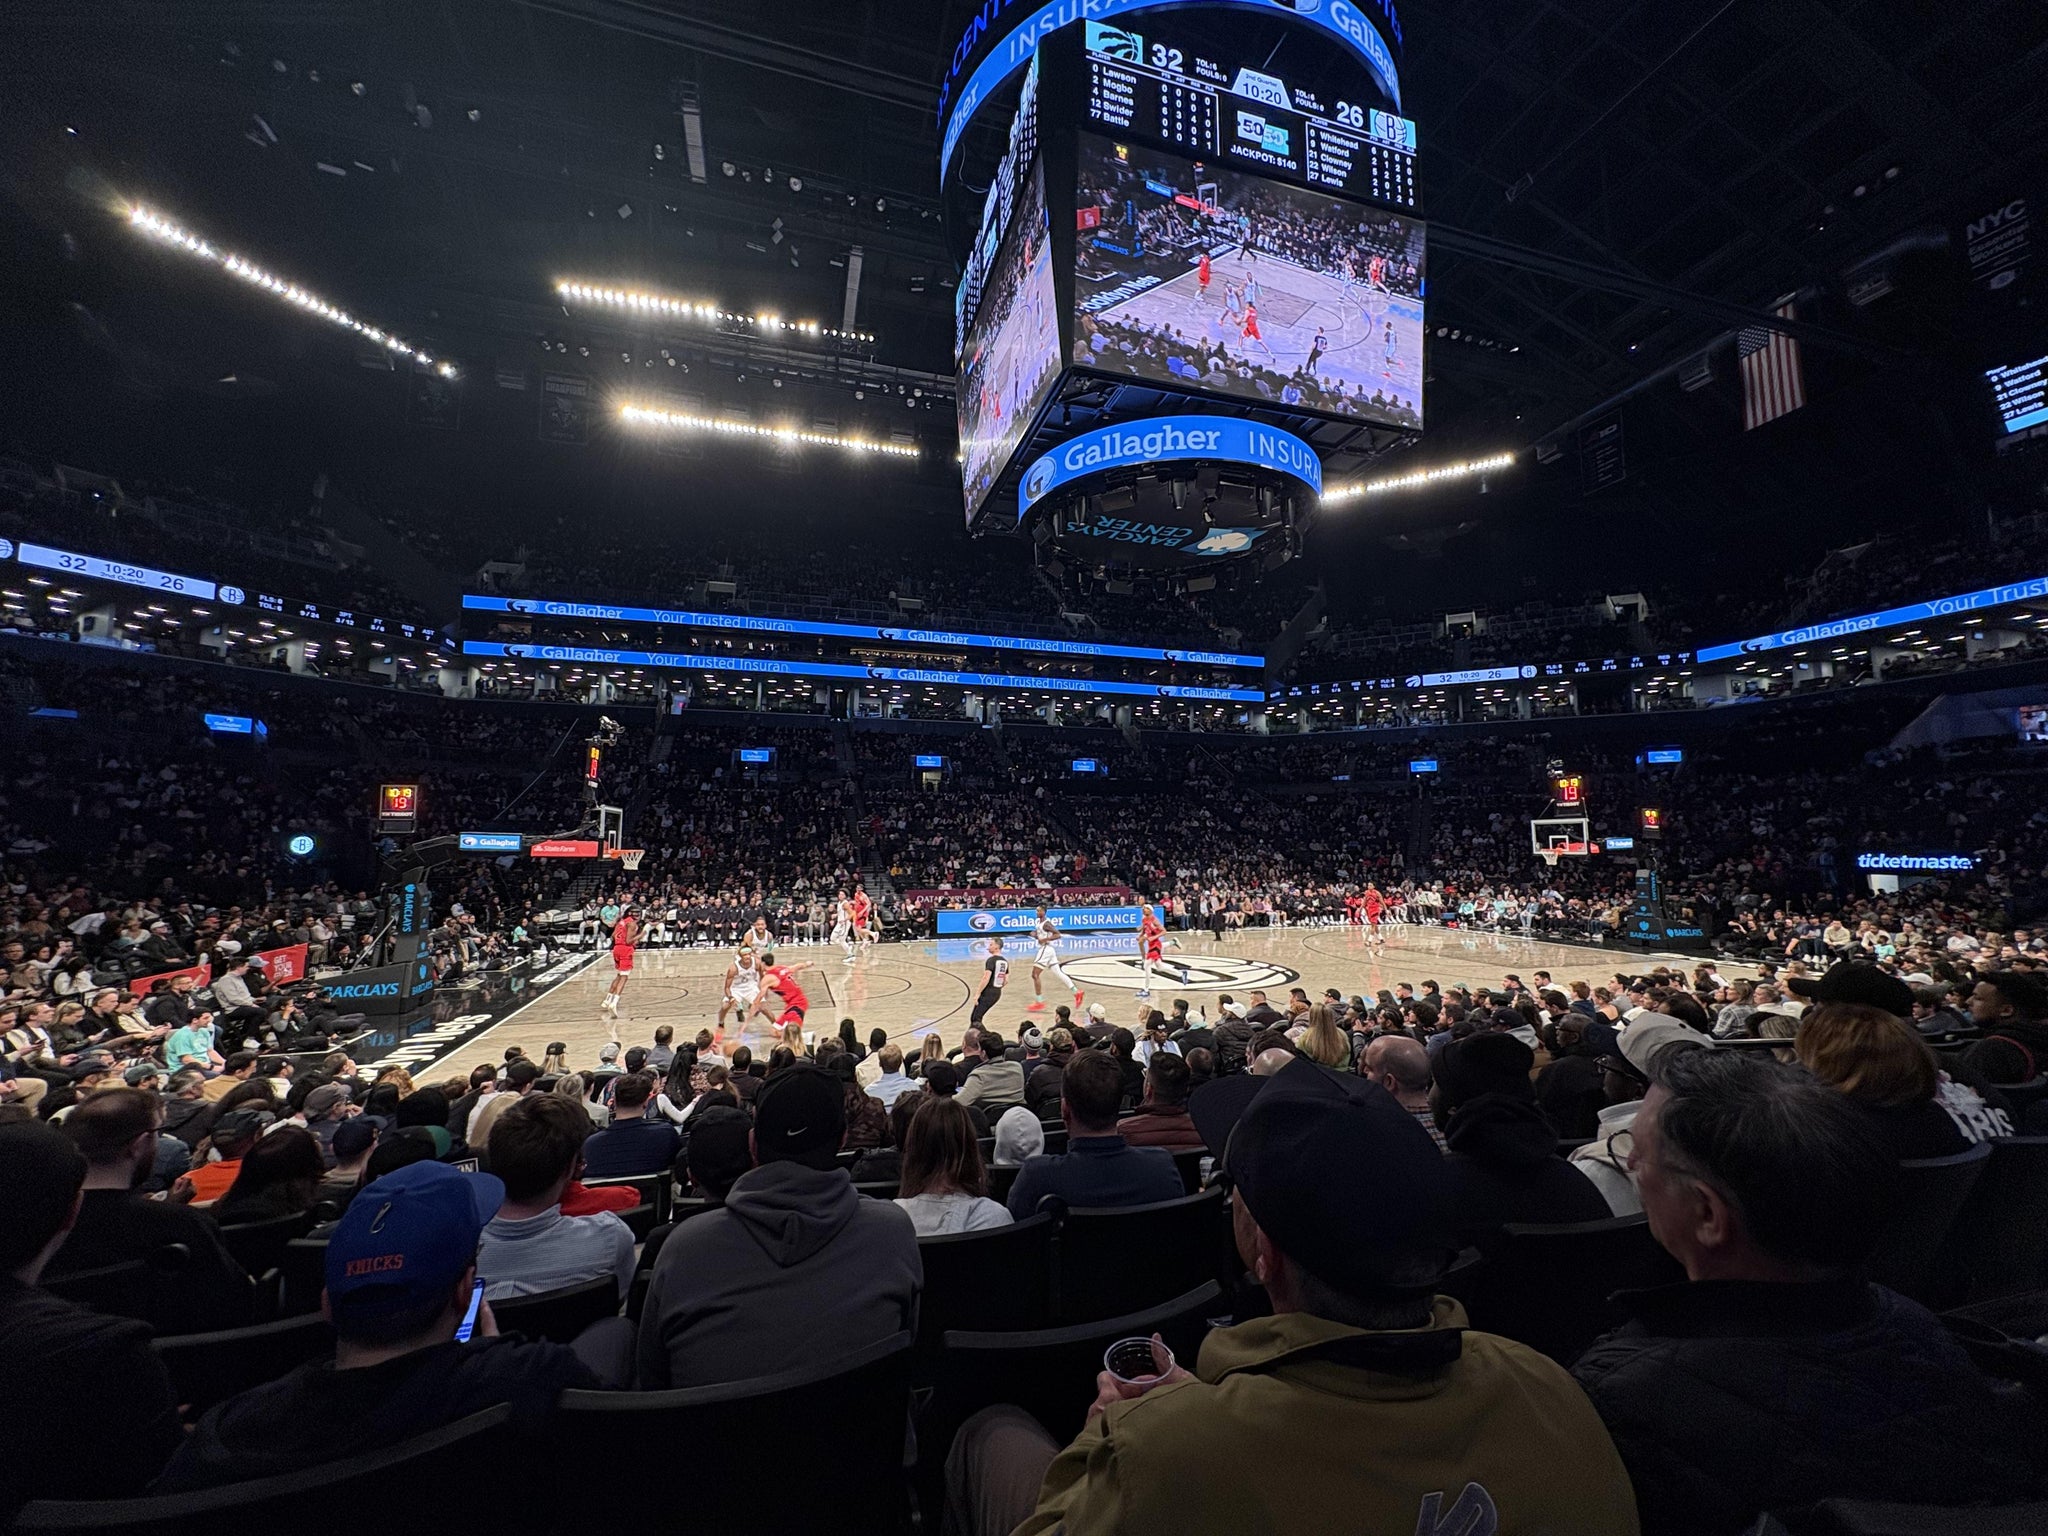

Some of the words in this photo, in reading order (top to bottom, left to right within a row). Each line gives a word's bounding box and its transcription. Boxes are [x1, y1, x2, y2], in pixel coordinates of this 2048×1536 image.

[1152, 43, 1183, 73] 32
[1092, 64, 1098, 72] 0
[1103, 66, 1136, 84] Lawson
[1257, 76, 1277, 87] Quarter
[1093, 76, 1098, 84] 2
[1103, 78, 1133, 94] Mogbo
[1243, 83, 1282, 105] 10:20
[1093, 87, 1098, 95] 4
[1103, 91, 1134, 106] Barnes
[1091, 98, 1101, 107] 12
[1103, 102, 1133, 117] Swider
[1336, 101, 1364, 128] 26
[1090, 109, 1101, 118] 77
[1104, 113, 1129, 127] Battle
[1243, 119, 1263, 136] 50
[1310, 129, 1315, 137] 0
[1320, 131, 1359, 149] Whitehead
[1231, 145, 1275, 165] JACKPOT:
[1277, 157, 1297, 170] $140
[1320, 142, 1350, 157] Watford
[1309, 150, 1317, 158] 21
[1320, 155, 1352, 170] Clowney
[1309, 161, 1318, 169] 22
[1321, 165, 1347, 178] Wilson
[1310, 171, 1318, 180] 27
[1322, 175, 1343, 187] Lewis
[1967, 200, 2025, 240] NYC
[2004, 369, 2041, 387] Watford
[1997, 393, 2008, 401] 21
[2008, 379, 2048, 396] Clowney
[2000, 402, 2012, 410] 22
[2012, 391, 2045, 405] Wilson
[2003, 410, 2014, 419] 27
[2016, 402, 2044, 414] Lewis
[1065, 425, 1220, 470] Gallagher
[59, 554, 87, 571] 32
[104, 564, 144, 579] 10:20
[160, 576, 184, 591] 26
[116, 576, 146, 585] Quarter
[544, 602, 623, 619] Gallagher
[653, 610, 685, 622] Your
[690, 613, 740, 627] Trusted
[1781, 616, 1880, 645] Gallagher
[1926, 596, 1980, 617] Your
[908, 630, 968, 645] Gallagher
[989, 636, 1015, 647] Your
[1019, 639, 1059, 651] Trusted
[1187, 651, 1237, 665] Gallagher
[542, 646, 620, 662] Gallagher
[646, 653, 679, 665] Your
[684, 655, 735, 669] Trusted
[898, 668, 960, 682] Gallagher
[979, 674, 1004, 685] Your
[1009, 676, 1049, 688] Trusted
[1181, 687, 1232, 700] Gallagher
[1439, 674, 1452, 683] 32
[1488, 670, 1501, 679] 26
[394, 797, 407, 808] 19
[1564, 787, 1577, 800] 19
[402, 893, 414, 932] BARCLAYS
[1070, 914, 1136, 925] INSURANCE
[1630, 931, 1661, 940] BARCLAYS
[1674, 928, 1703, 937] BARCLAYS
[412, 980, 433, 996] BARCLAYS
[346, 1254, 404, 1277] KNICKS
